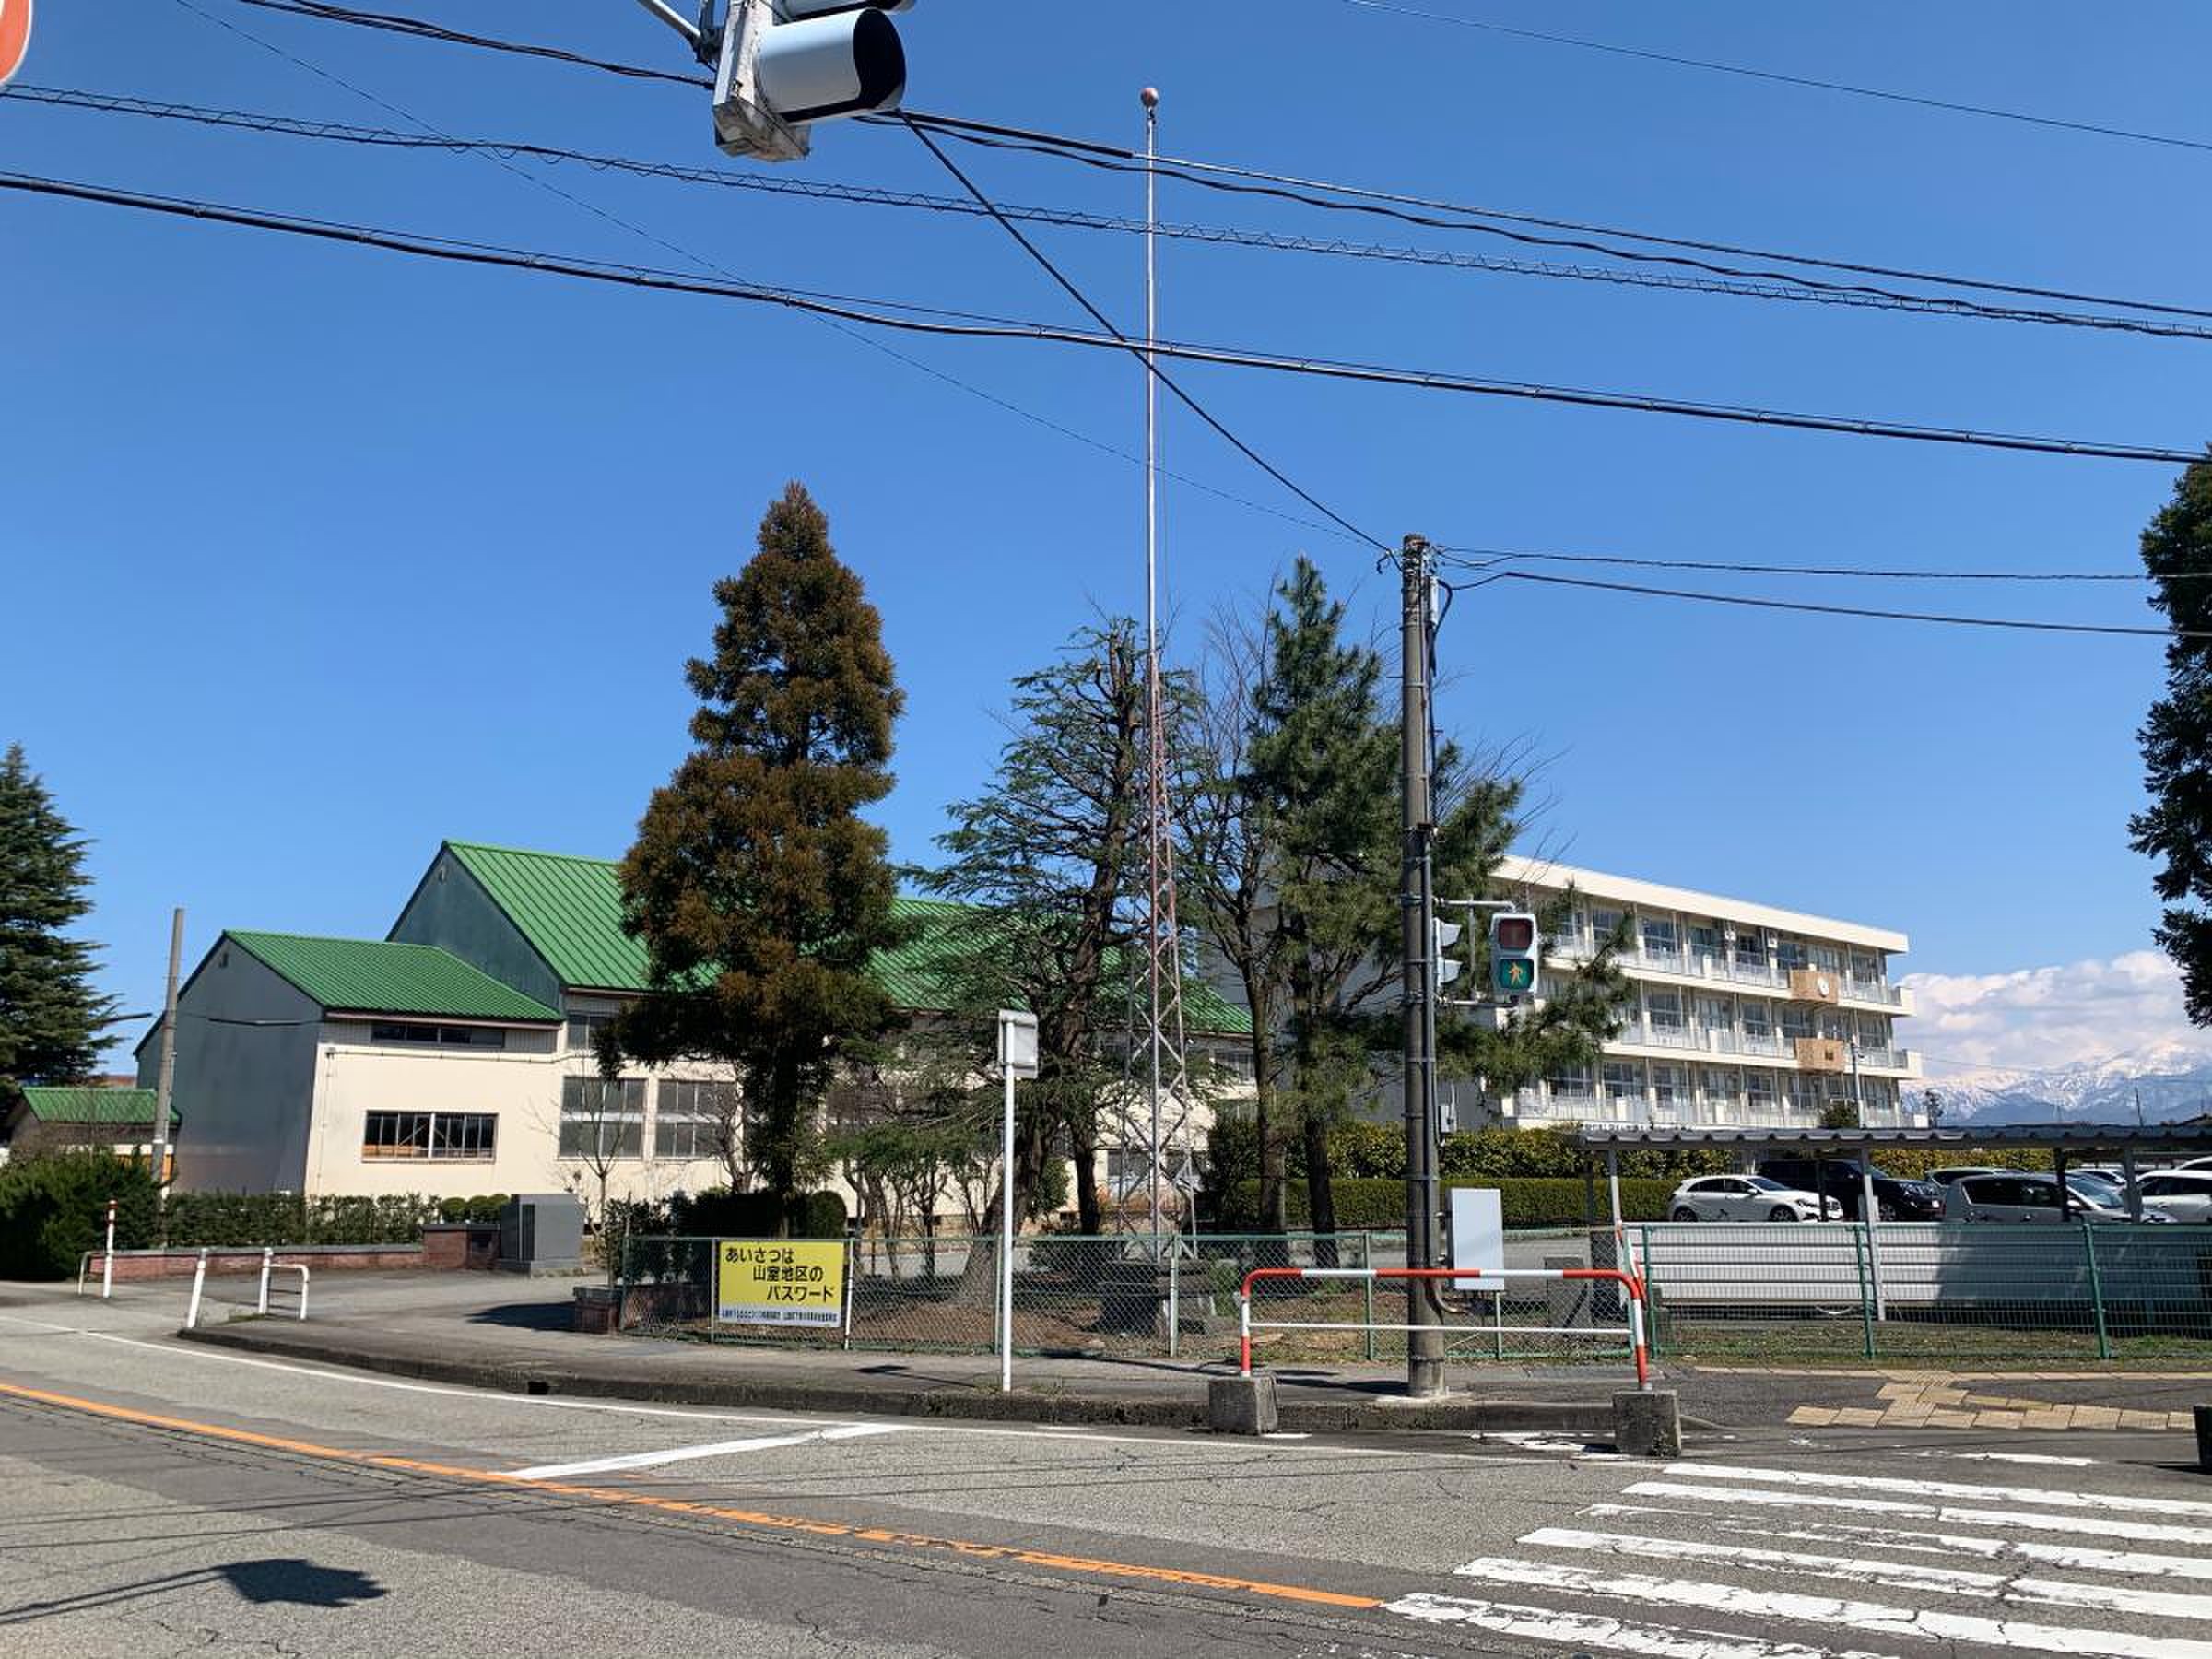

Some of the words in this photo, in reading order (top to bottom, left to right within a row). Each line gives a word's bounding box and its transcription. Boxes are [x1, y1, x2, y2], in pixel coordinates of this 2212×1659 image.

[725, 1247, 794, 1264] あいさつは
[753, 1266, 824, 1282] 山室地区の
[767, 1285, 834, 1302] パスワード
